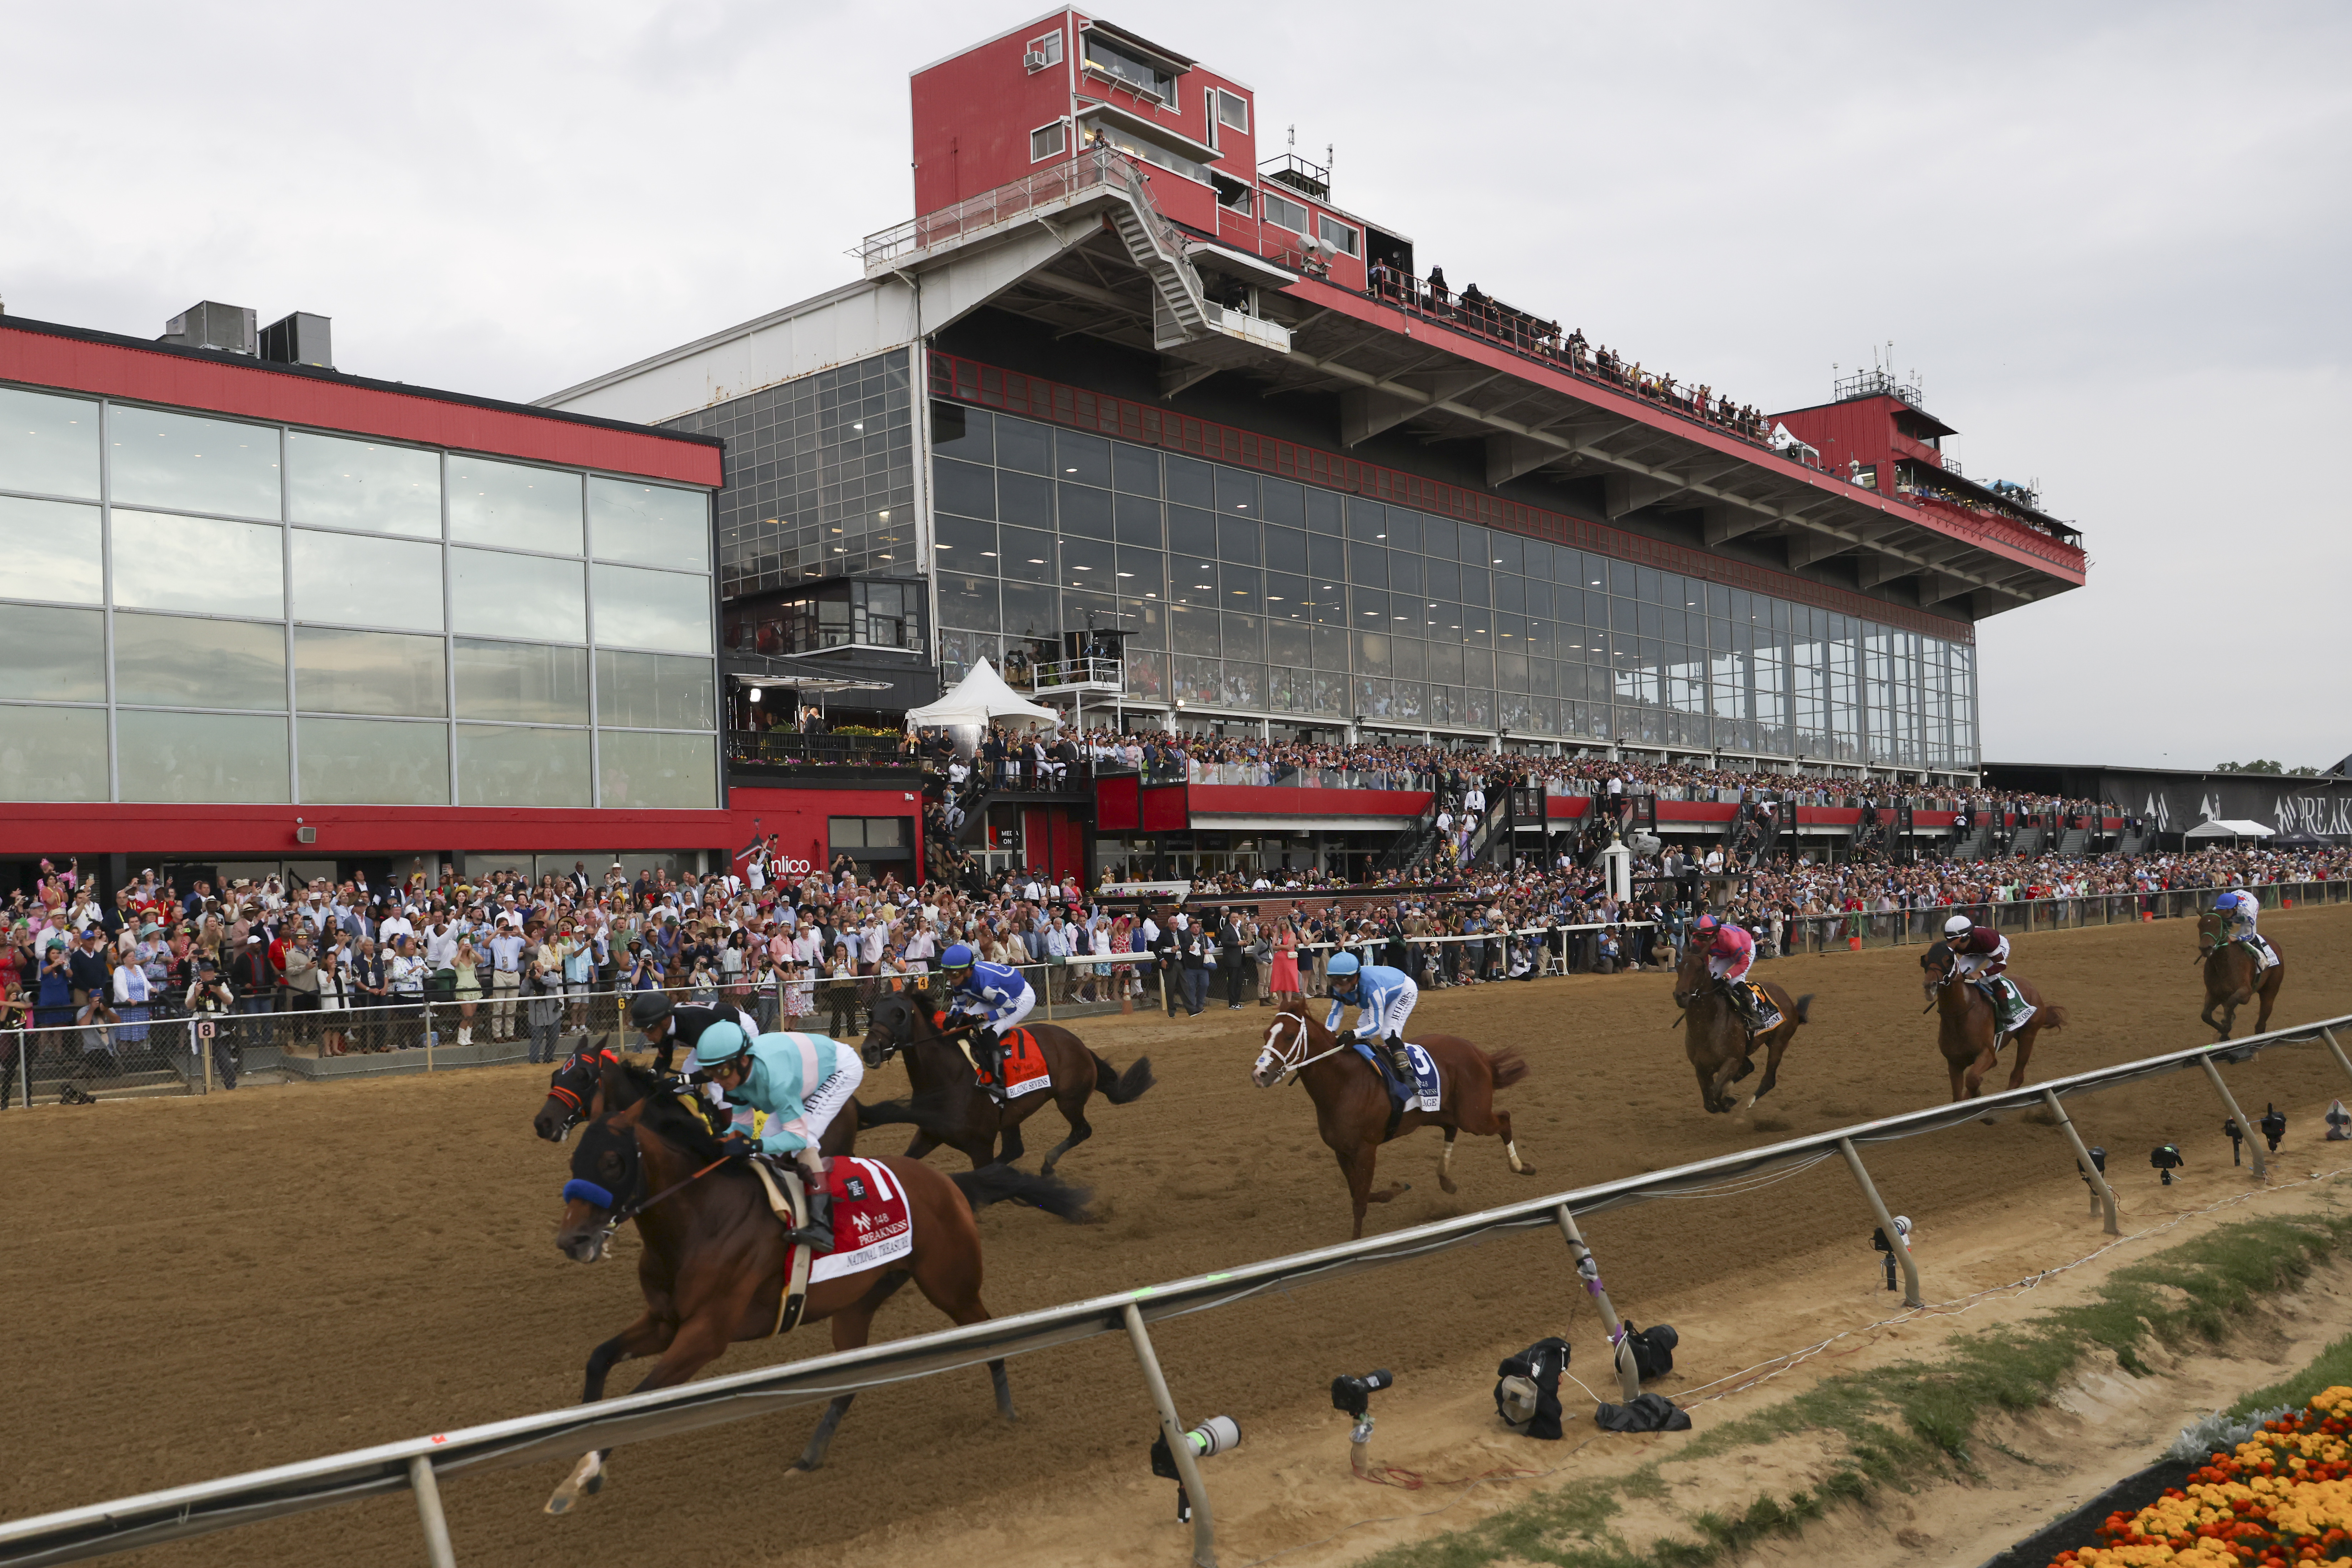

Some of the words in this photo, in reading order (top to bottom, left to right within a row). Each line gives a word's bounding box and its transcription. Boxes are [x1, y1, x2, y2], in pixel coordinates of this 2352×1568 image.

[920, 978, 926, 988] 4
[618, 998, 625, 1009] 6
[2022, 1009, 2033, 1019] ONE
[202, 1024, 211, 1036] 8
[1413, 1044, 1430, 1075] 3
[1029, 1078, 1048, 1089] SEVENS
[1422, 1098, 1437, 1107] AGE
[849, 1157, 894, 1202] 1
[852, 1186, 864, 1196] BET
[874, 1213, 890, 1225] 148
[858, 1219, 908, 1246] PREAKNESS
